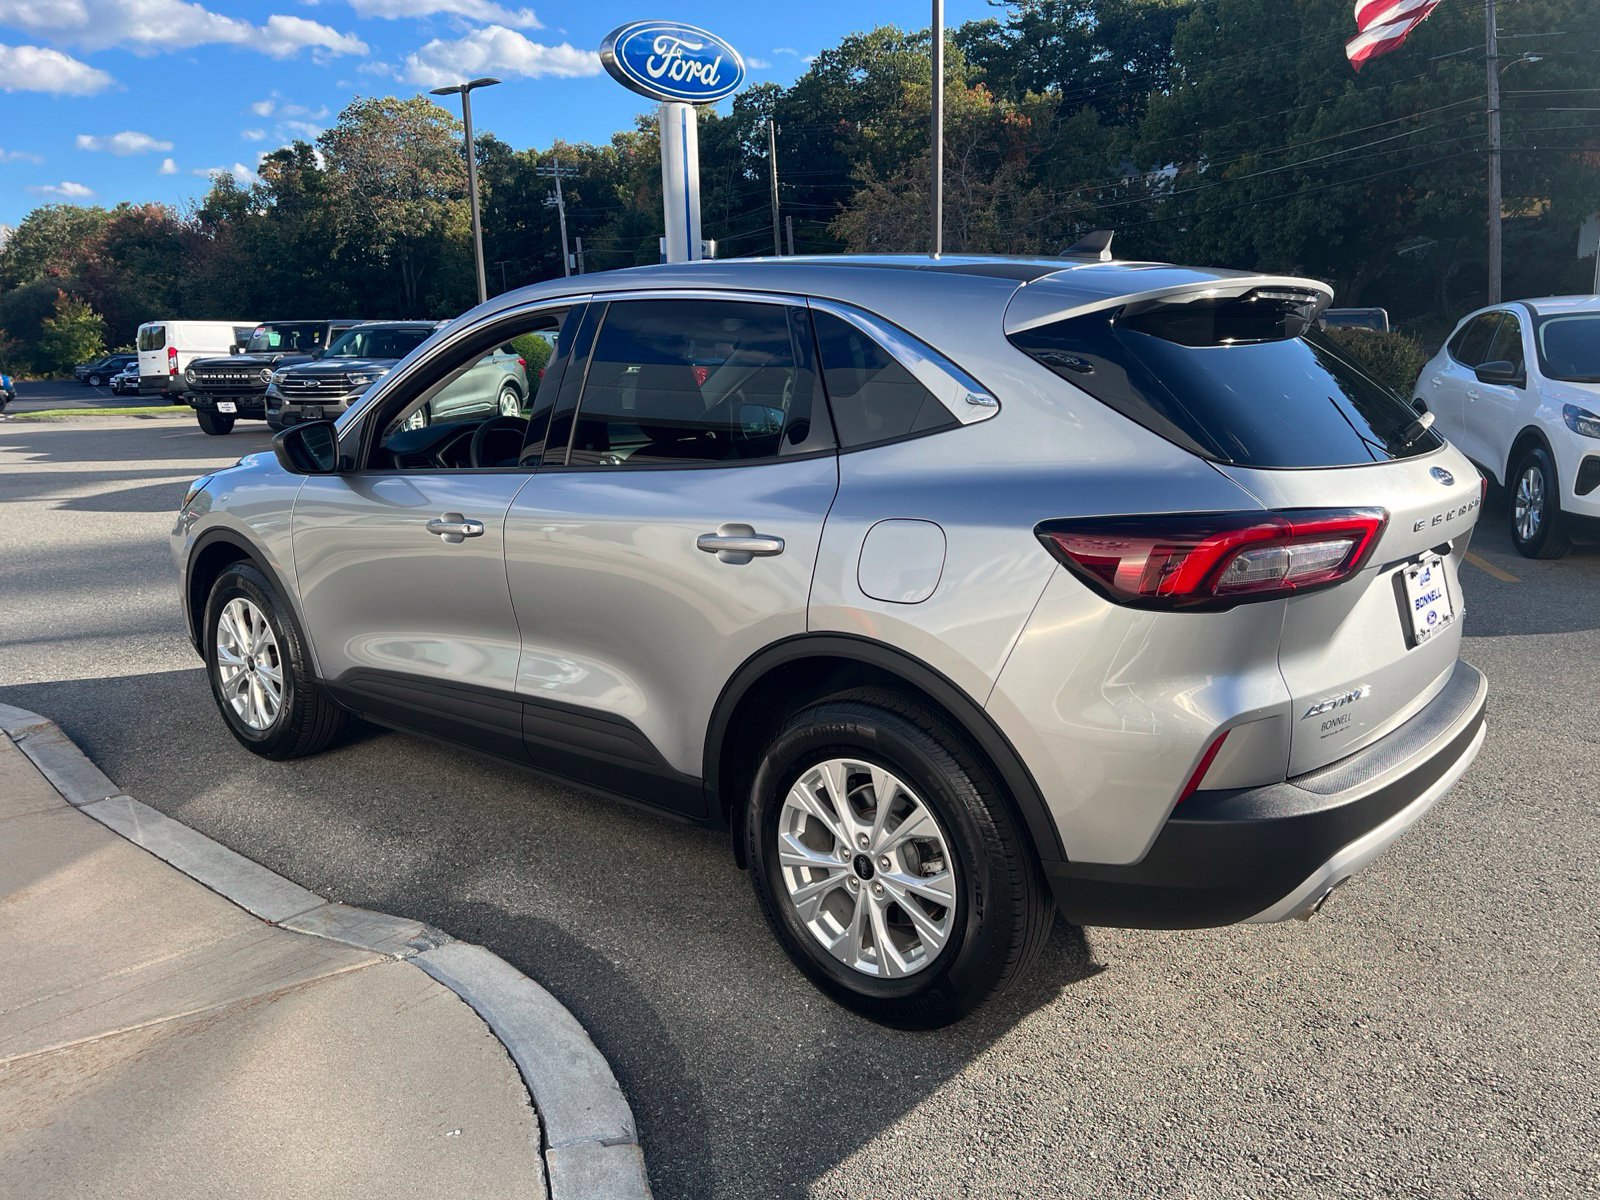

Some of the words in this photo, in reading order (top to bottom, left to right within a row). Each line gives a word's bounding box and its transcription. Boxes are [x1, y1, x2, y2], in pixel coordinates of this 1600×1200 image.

[646, 35, 722, 87] Ford
[1415, 587, 1442, 611] BONNELL
[1320, 713, 1352, 732] BONNELL
